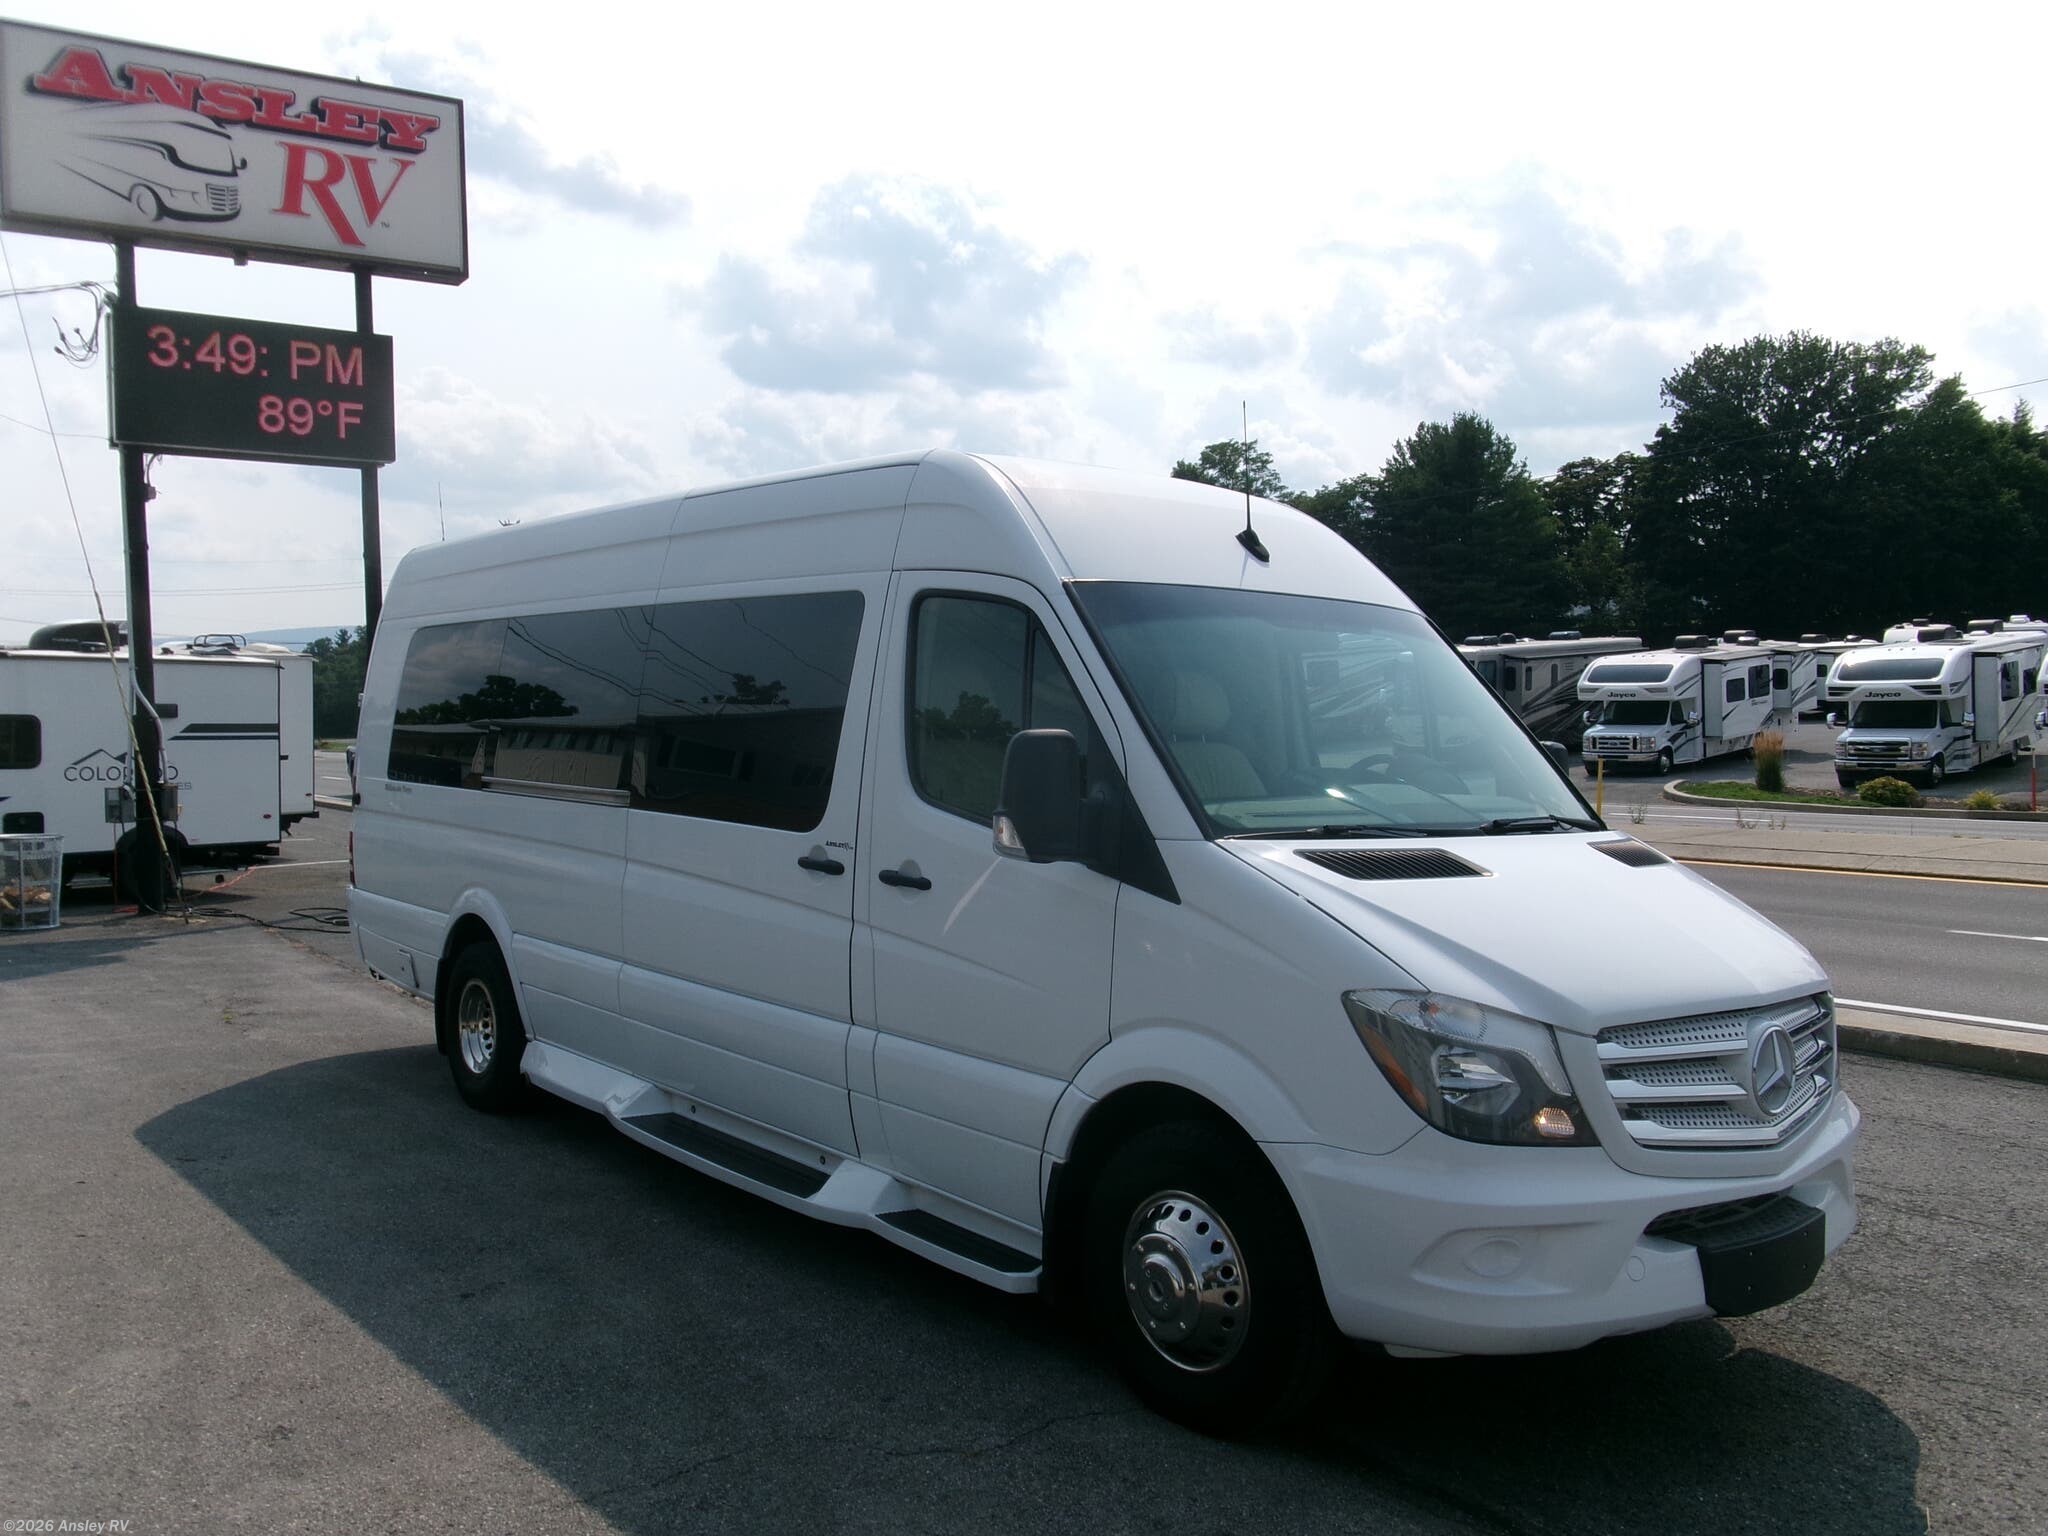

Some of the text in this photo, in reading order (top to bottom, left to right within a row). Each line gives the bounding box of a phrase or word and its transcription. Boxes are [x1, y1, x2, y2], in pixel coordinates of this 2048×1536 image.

[28, 46, 441, 154] ANSLEY
[271, 140, 416, 248] RV
[289, 340, 365, 388] PM
[258, 395, 365, 440] 89°F
[1607, 691, 1637, 699] Jayco
[1865, 691, 1903, 699] Jayco
[63, 765, 179, 782] COLORO
